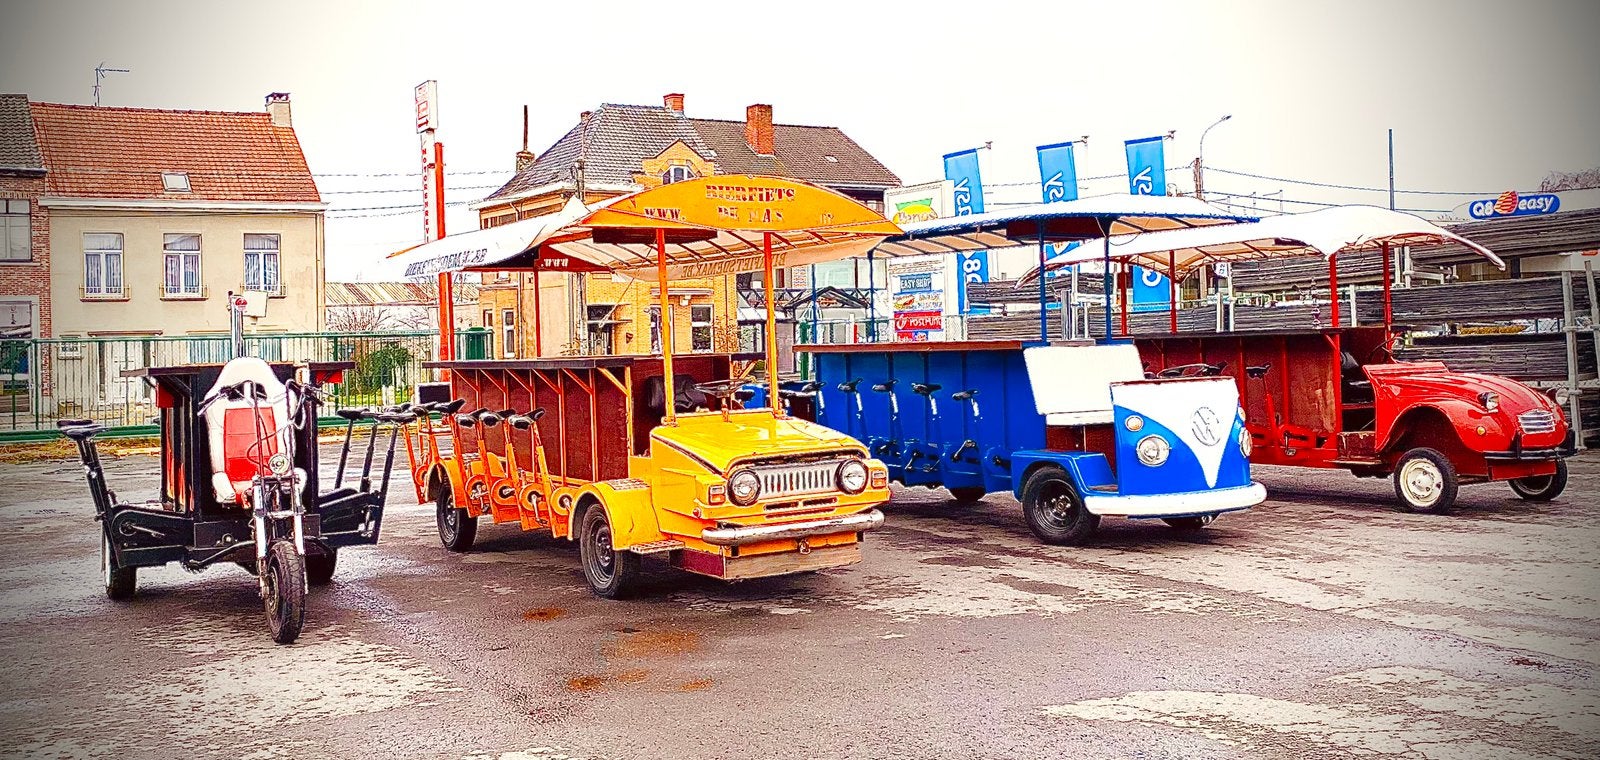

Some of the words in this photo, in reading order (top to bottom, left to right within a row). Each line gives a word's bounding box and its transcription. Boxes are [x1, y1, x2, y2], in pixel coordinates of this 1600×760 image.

[421, 148, 430, 242] MOTORENREVI
[706, 185, 795, 202] BIERFIETS
[1472, 201, 1494, 217] Q8
[1518, 196, 1554, 212] easy
[901, 279, 916, 290] EASY
